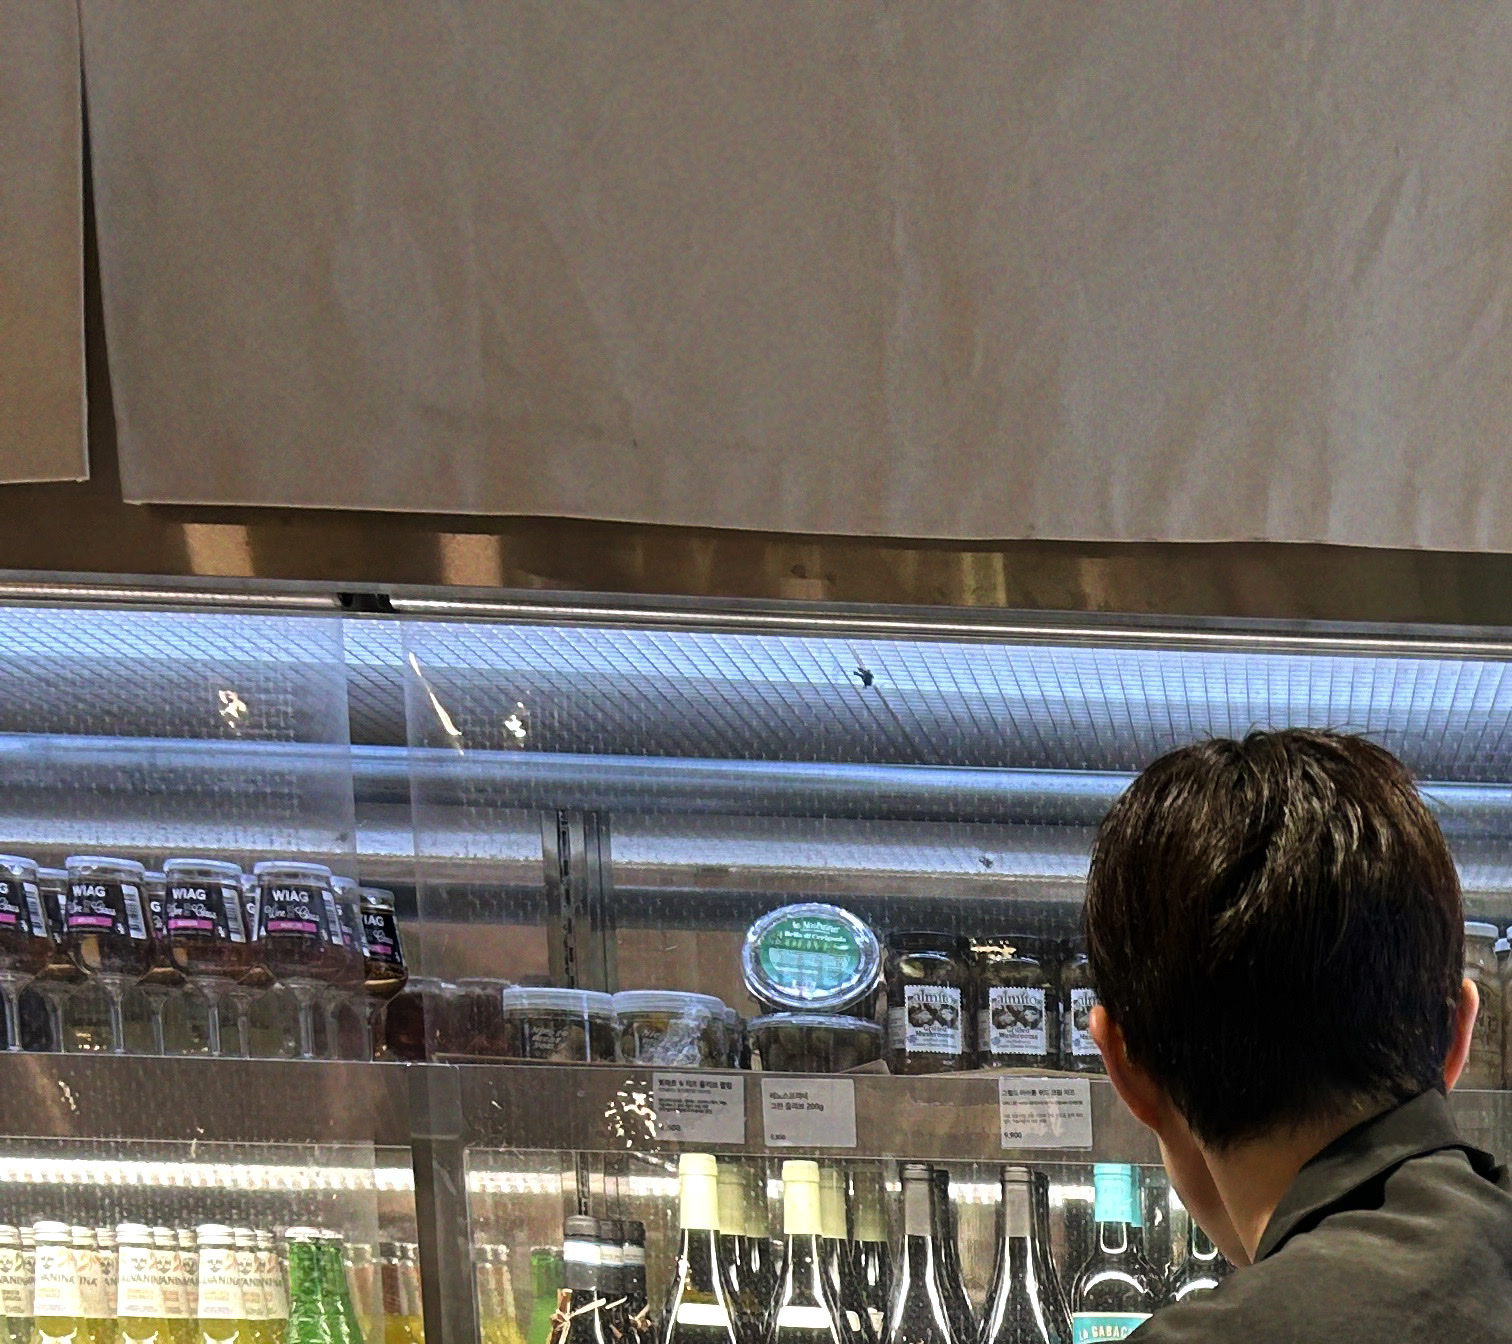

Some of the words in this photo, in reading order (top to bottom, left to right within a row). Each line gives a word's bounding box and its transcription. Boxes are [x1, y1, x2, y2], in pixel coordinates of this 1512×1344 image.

[72, 885, 106, 898] WIAG
[171, 887, 207, 901] WIAG
[272, 889, 310, 903] WIAG
[363, 915, 385, 927] IAG
[1091, 1325, 1135, 1338] GABAC
